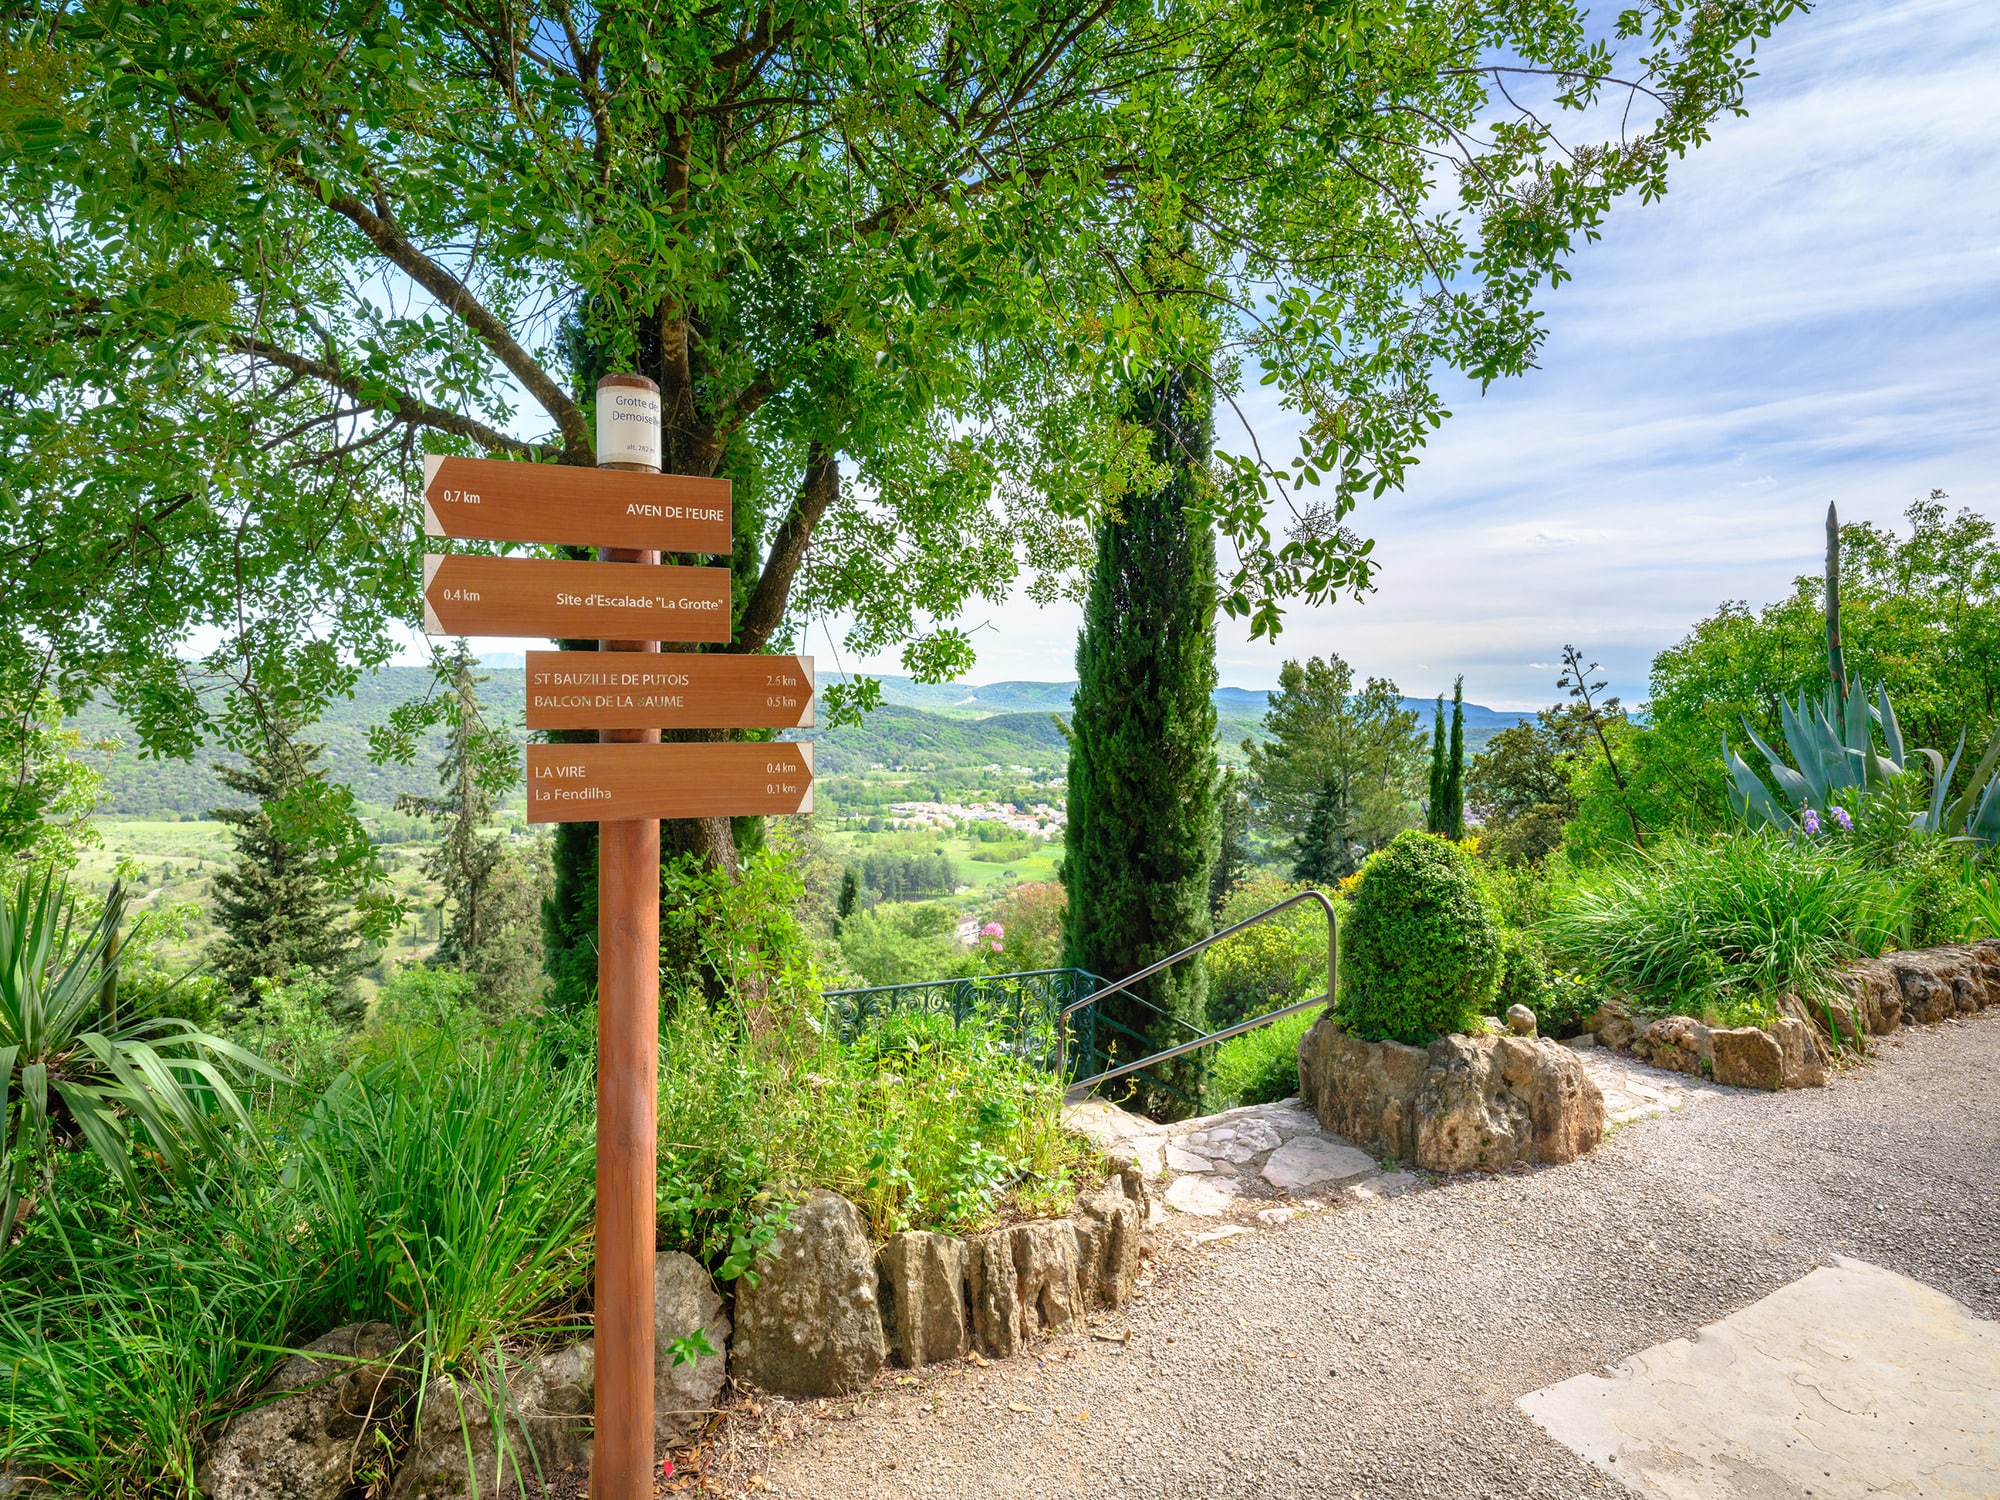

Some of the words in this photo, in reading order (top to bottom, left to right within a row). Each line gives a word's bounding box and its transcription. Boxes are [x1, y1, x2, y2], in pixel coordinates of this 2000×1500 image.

[616, 396, 647, 408] Grotte
[443, 490, 461, 503] 0.7
[463, 491, 481, 504] km
[626, 503, 662, 517] AVEN
[665, 506, 683, 518] DE
[443, 589, 461, 601] 0.4
[463, 590, 480, 602] km
[556, 593, 582, 606] Site
[585, 594, 653, 608] d'Escalade
[656, 597, 675, 609] "La
[678, 598, 723, 611] Grotte"
[534, 673, 551, 685] ST
[554, 673, 618, 686] BAUZILLE
[621, 674, 639, 686] DE
[642, 674, 689, 686] PUTOIS
[767, 675, 781, 687] 2.6
[782, 675, 797, 686] km
[534, 695, 592, 708] BALCON
[595, 695, 614, 708] DE
[616, 695, 634, 707] LA
[767, 697, 781, 708] 0.5
[782, 697, 797, 708] km
[535, 766, 552, 778] LA
[556, 766, 586, 778] VIRE
[767, 763, 781, 774] 0.4
[782, 763, 797, 773] km
[535, 789, 551, 801] La
[554, 787, 612, 801] Fendilha
[767, 784, 781, 795] 0.1
[782, 783, 797, 794] km
